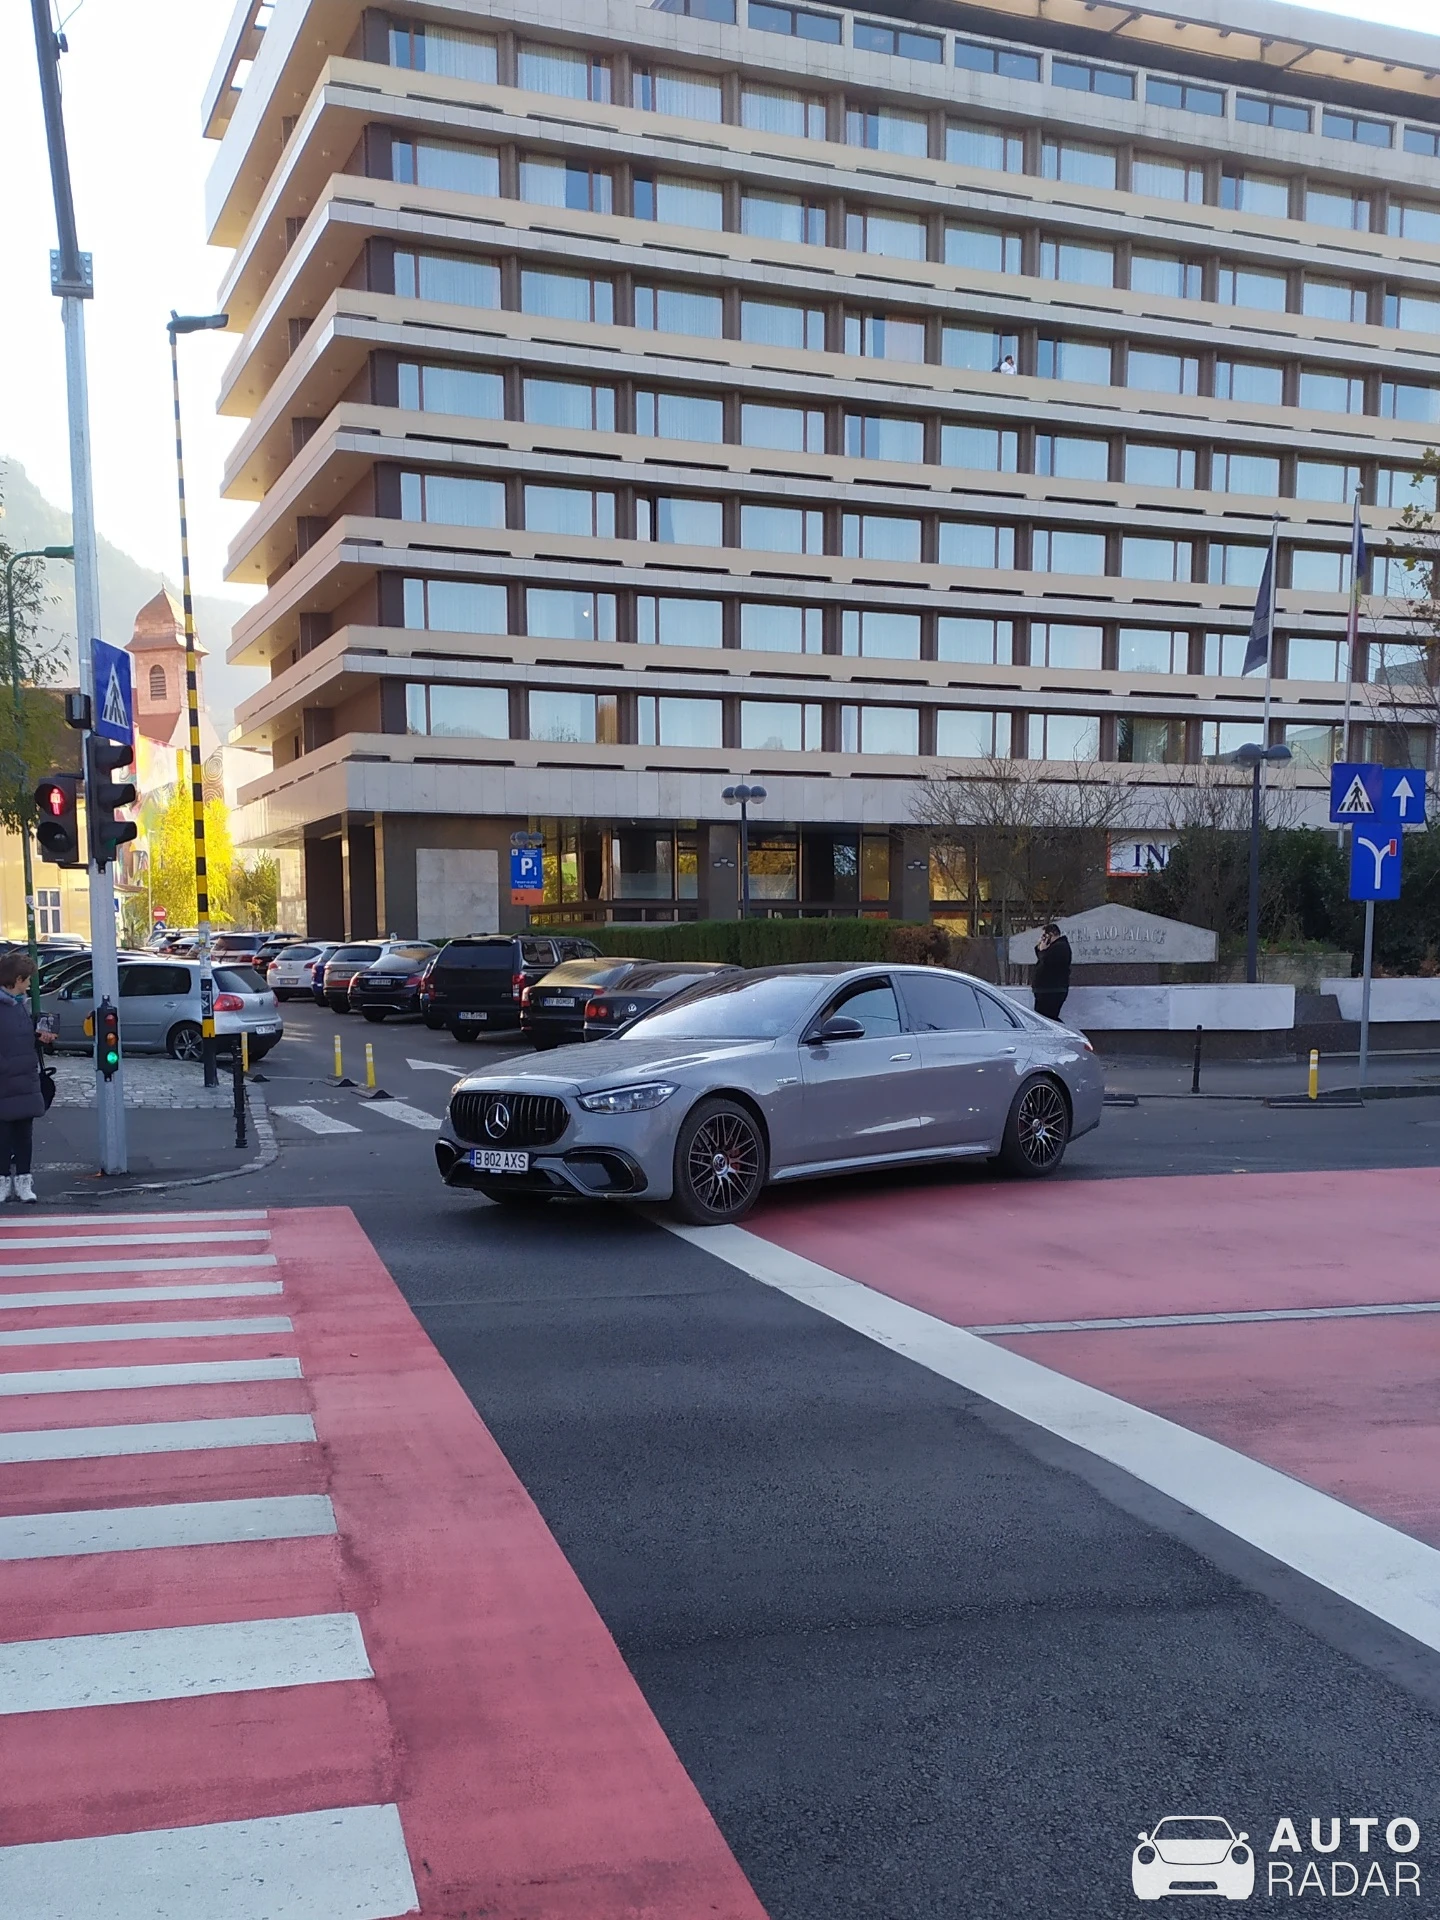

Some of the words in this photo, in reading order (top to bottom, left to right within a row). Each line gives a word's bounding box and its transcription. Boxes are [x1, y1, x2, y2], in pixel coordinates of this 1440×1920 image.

[521, 857, 533, 876] P
[1122, 926, 1167, 945] PALACE
[475, 1151, 482, 1166] B
[484, 1152, 501, 1167] 802
[504, 1153, 526, 1169] AXS
